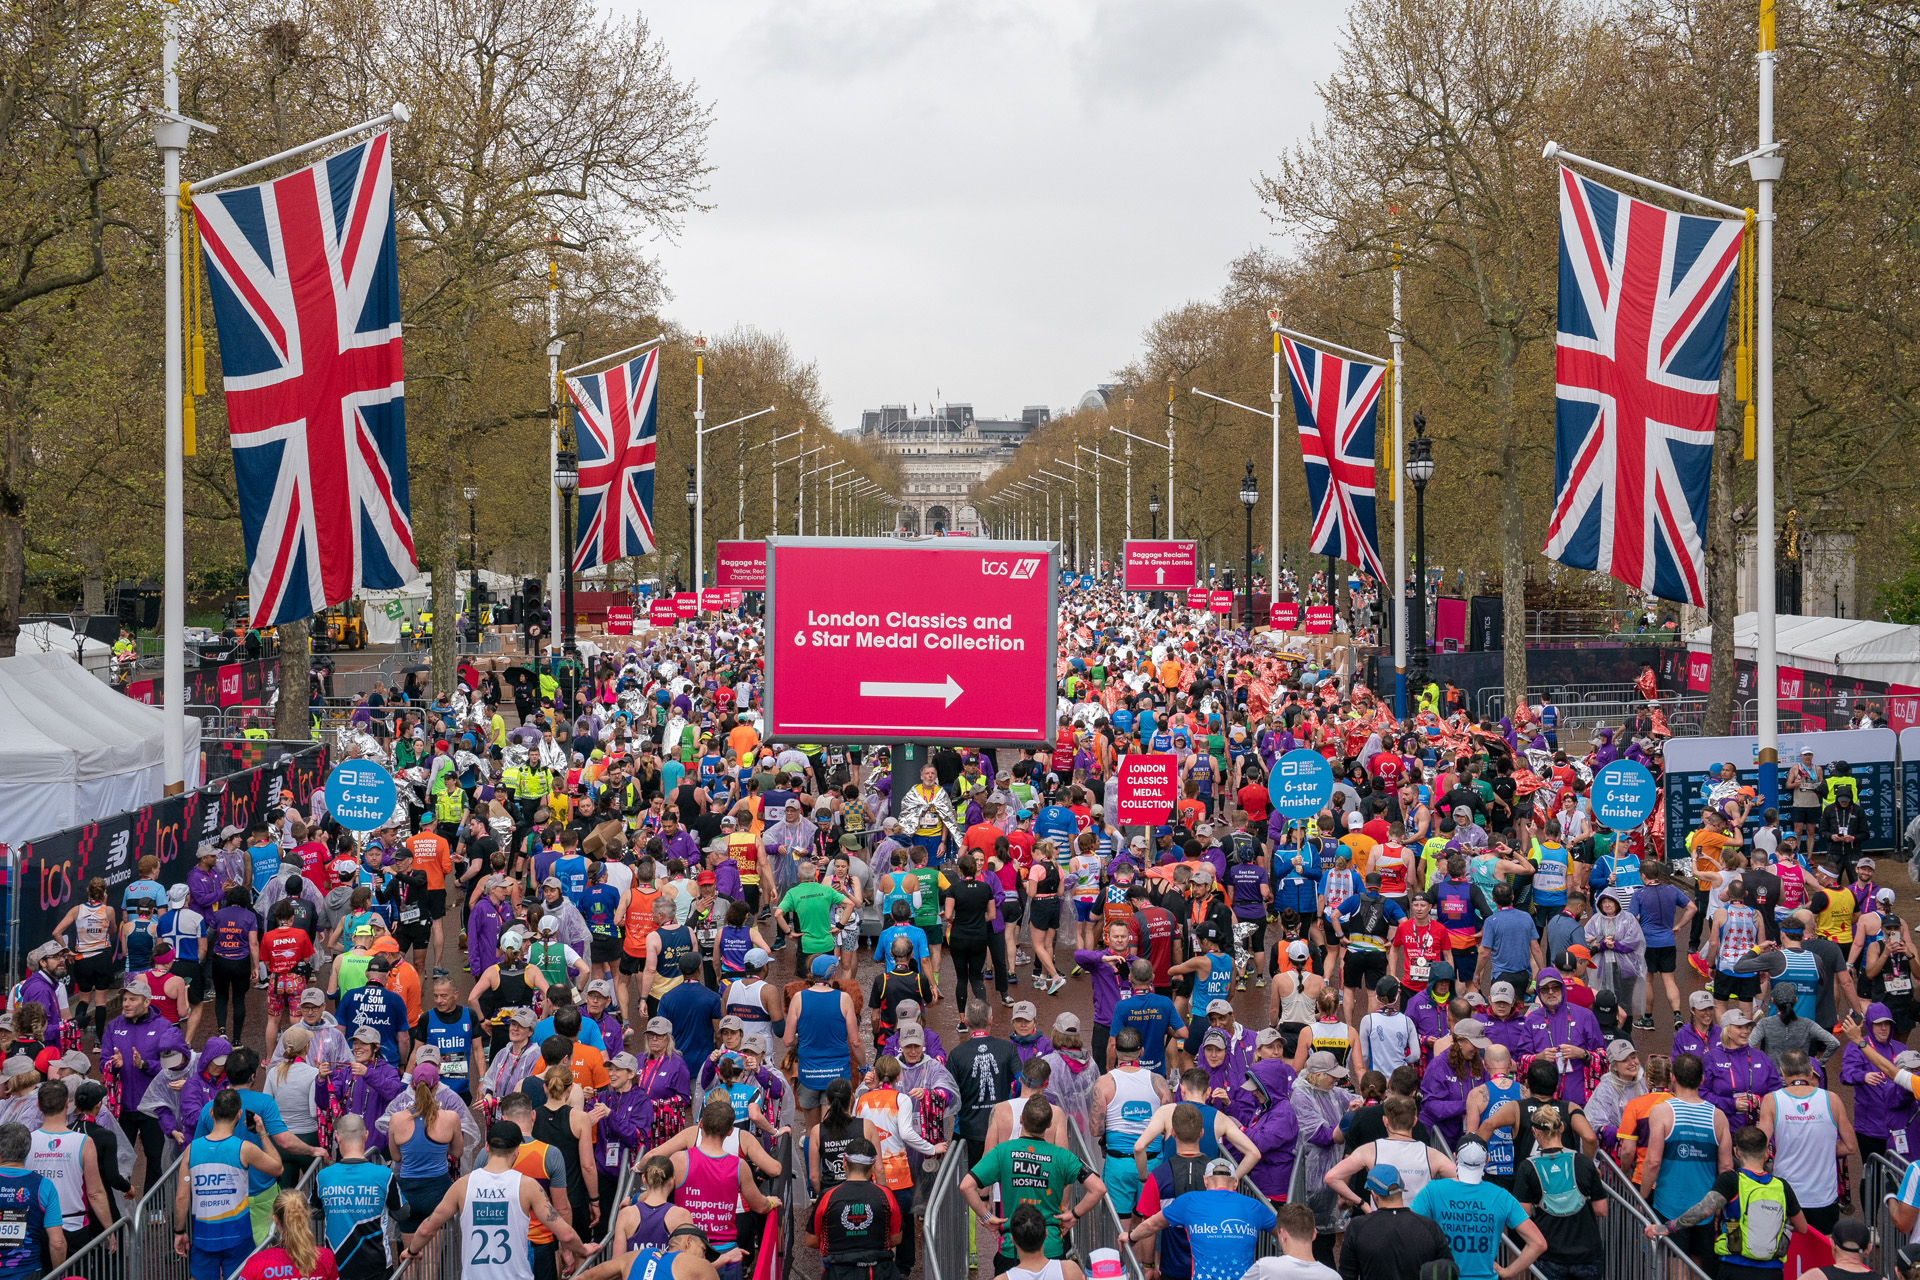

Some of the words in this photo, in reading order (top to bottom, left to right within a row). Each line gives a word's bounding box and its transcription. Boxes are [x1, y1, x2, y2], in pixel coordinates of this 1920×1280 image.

[982, 558, 1008, 575] tcs
[808, 610, 879, 627] London
[886, 612, 967, 629] Classics
[973, 614, 1012, 630] and
[794, 630, 806, 646] 6
[812, 631, 850, 647] Star
[856, 632, 918, 648] Medal
[924, 633, 1024, 651] Collection
[1692, 661, 1700, 678] tcs
[222, 677, 231, 693] tcs
[246, 672, 256, 690] tcs
[1781, 678, 1790, 696] tcs
[204, 684, 216, 704] tcs
[1894, 699, 1905, 718] tcs
[1129, 764, 1166, 774] LONDON
[1126, 776, 1168, 784] CLASSICS
[298, 768, 314, 806] tcs
[1133, 788, 1162, 797] MEDAL
[1284, 780, 1318, 793] 6-star
[342, 790, 380, 804] 6-star
[1280, 795, 1322, 808] finisher
[1606, 790, 1640, 802] 6-star
[232, 790, 249, 830] tcs
[1121, 800, 1174, 809] COLLECTION
[337, 804, 384, 820] finisher
[1601, 804, 1644, 818] finisher
[156, 819, 178, 864] tcs
[111, 868, 132, 884] balance
[40, 858, 71, 912] tcs
[1146, 920, 1171, 928] CHAMPION
[273, 938, 296, 946] JENNA
[1149, 932, 1170, 940] CHILDREN
[1212, 971, 1231, 980] DAN
[364, 988, 382, 996] FOR
[354, 994, 365, 1002] MY
[368, 996, 384, 1004] SON
[360, 1003, 386, 1013] AUSTIN
[366, 1016, 391, 1026] mind
[438, 1036, 465, 1049] italia
[442, 1064, 462, 1072] 45261
[1012, 1152, 1052, 1162] PROTECTING
[1014, 1162, 1040, 1175] PLAY
[194, 1174, 226, 1186] JDRF
[322, 1186, 354, 1196] GOING
[358, 1186, 378, 1196] THE
[476, 1188, 506, 1199] MAX
[686, 1187, 700, 1196] I'm
[324, 1196, 352, 1206] EXTRA
[355, 1196, 380, 1206] MILE
[684, 1199, 734, 1212] supporting
[1449, 1200, 1486, 1210] ROYAL
[476, 1206, 505, 1217] relate
[851, 1203, 864, 1214] 100
[692, 1212, 715, 1220] eople
[1441, 1212, 1494, 1223] WINDSOR
[710, 1223, 728, 1232] loss
[1442, 1224, 1494, 1234] TRIATHLON
[471, 1229, 512, 1266] 23
[264, 1265, 294, 1278] OUR
